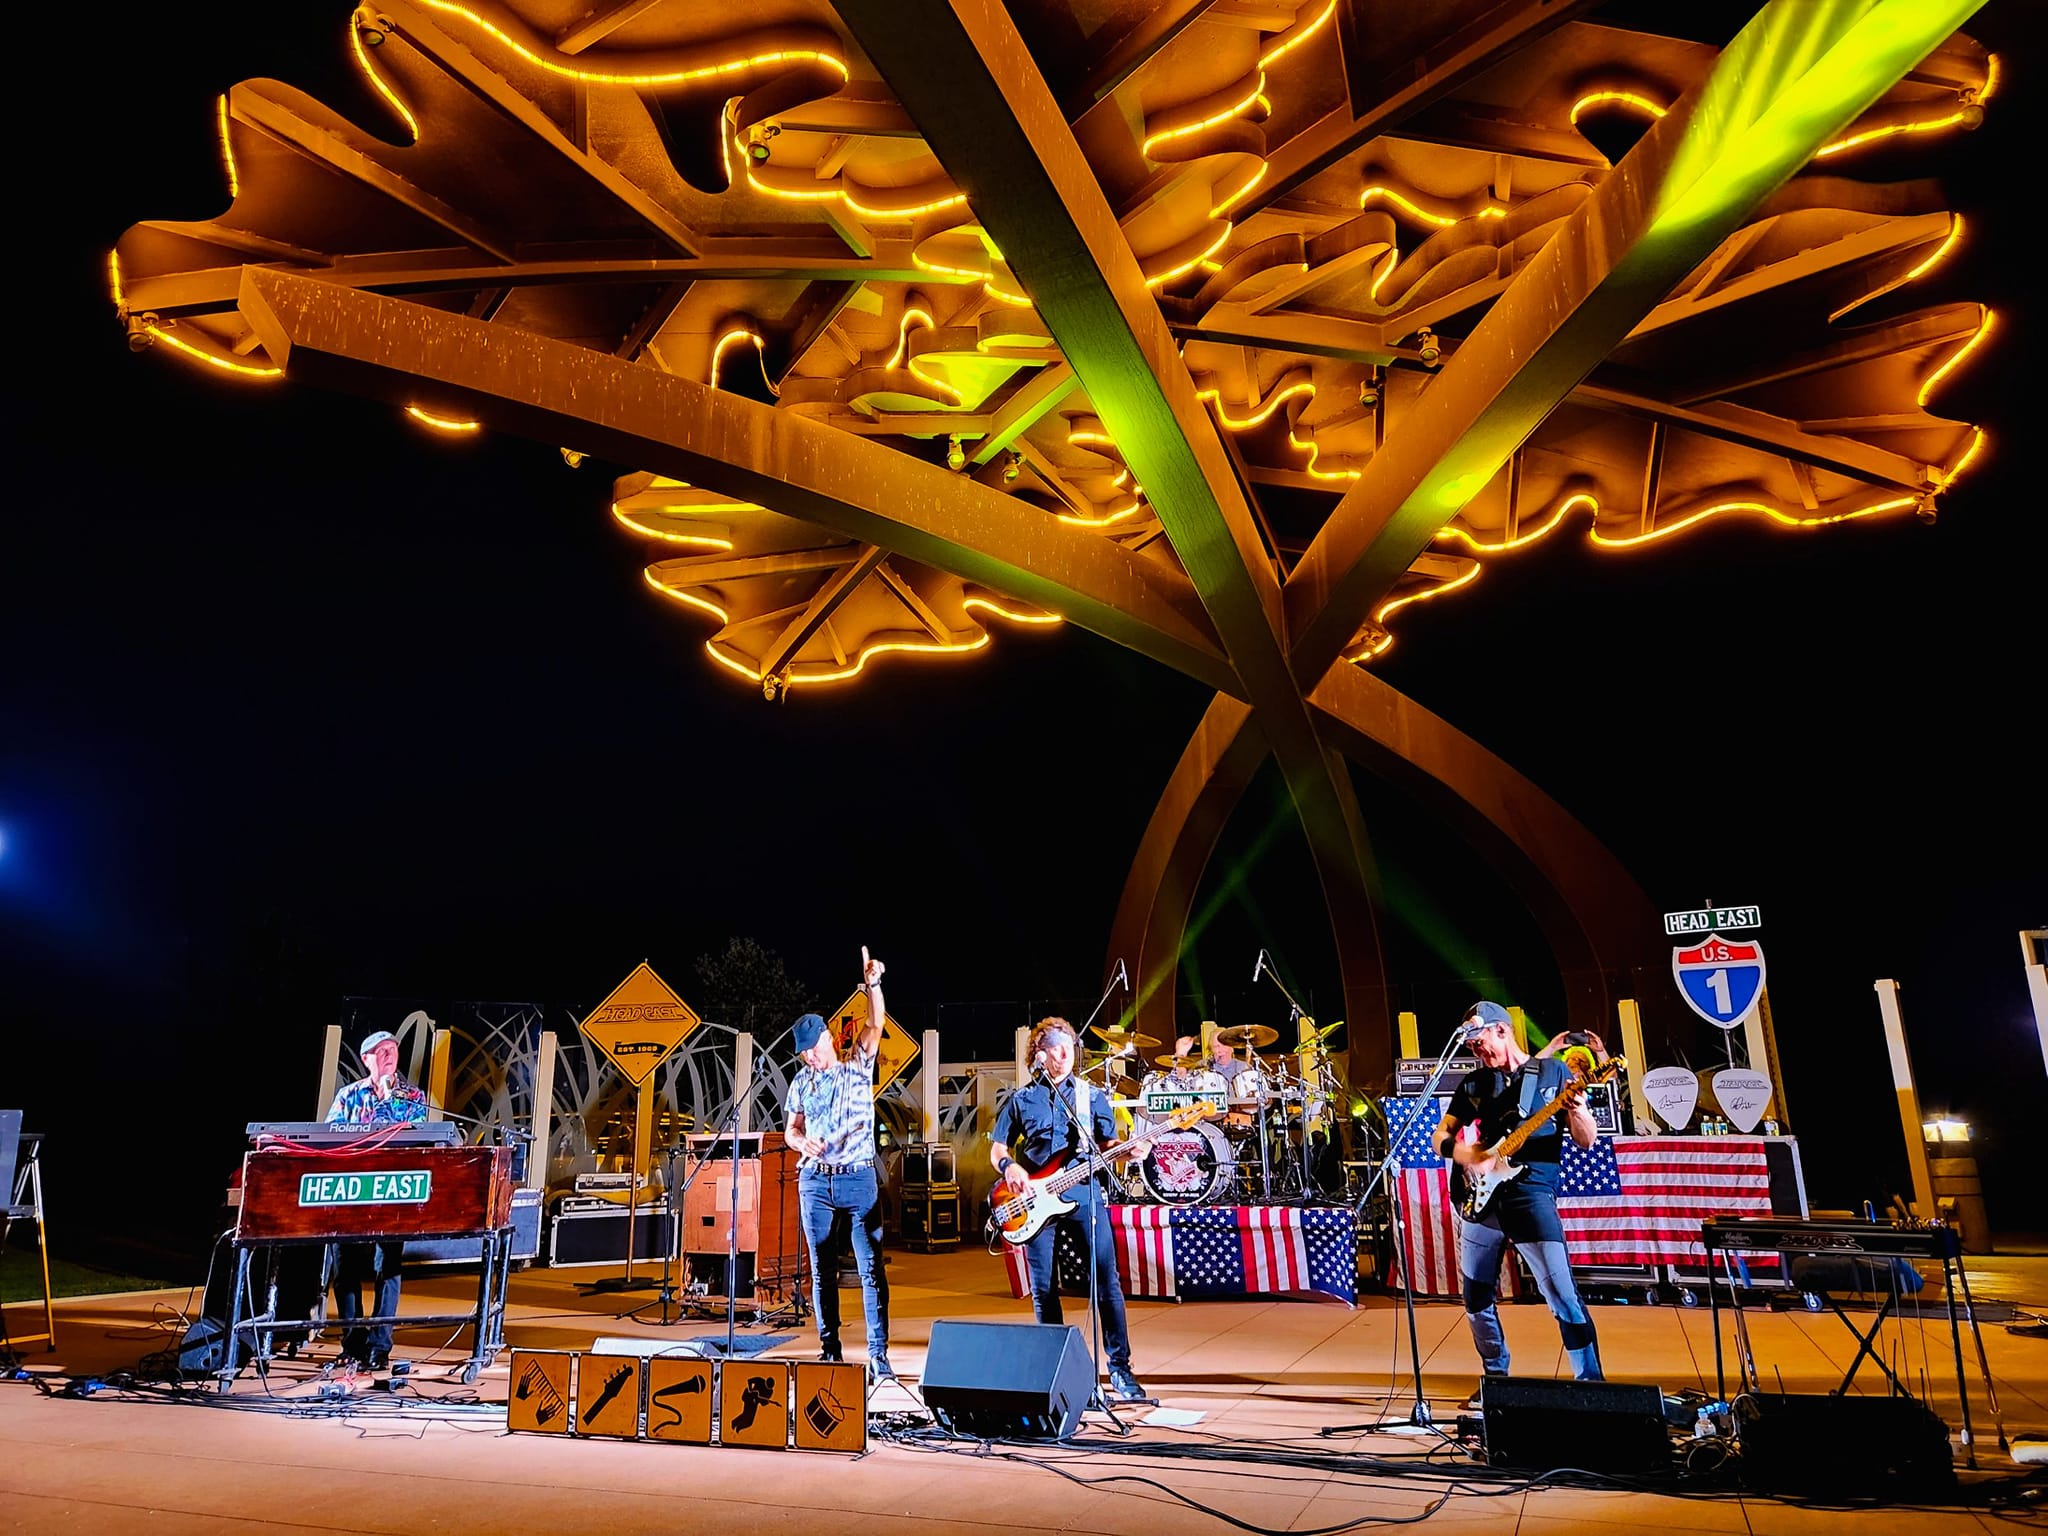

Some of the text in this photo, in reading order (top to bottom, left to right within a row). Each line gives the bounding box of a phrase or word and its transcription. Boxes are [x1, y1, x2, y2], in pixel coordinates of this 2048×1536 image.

[1669, 909, 1755, 932] HEAD EAST
[1701, 946, 1733, 961] U.S.
[1705, 969, 1732, 1014] 1
[329, 1123, 371, 1133] Roland
[305, 1174, 425, 1201] HEAD EAST
